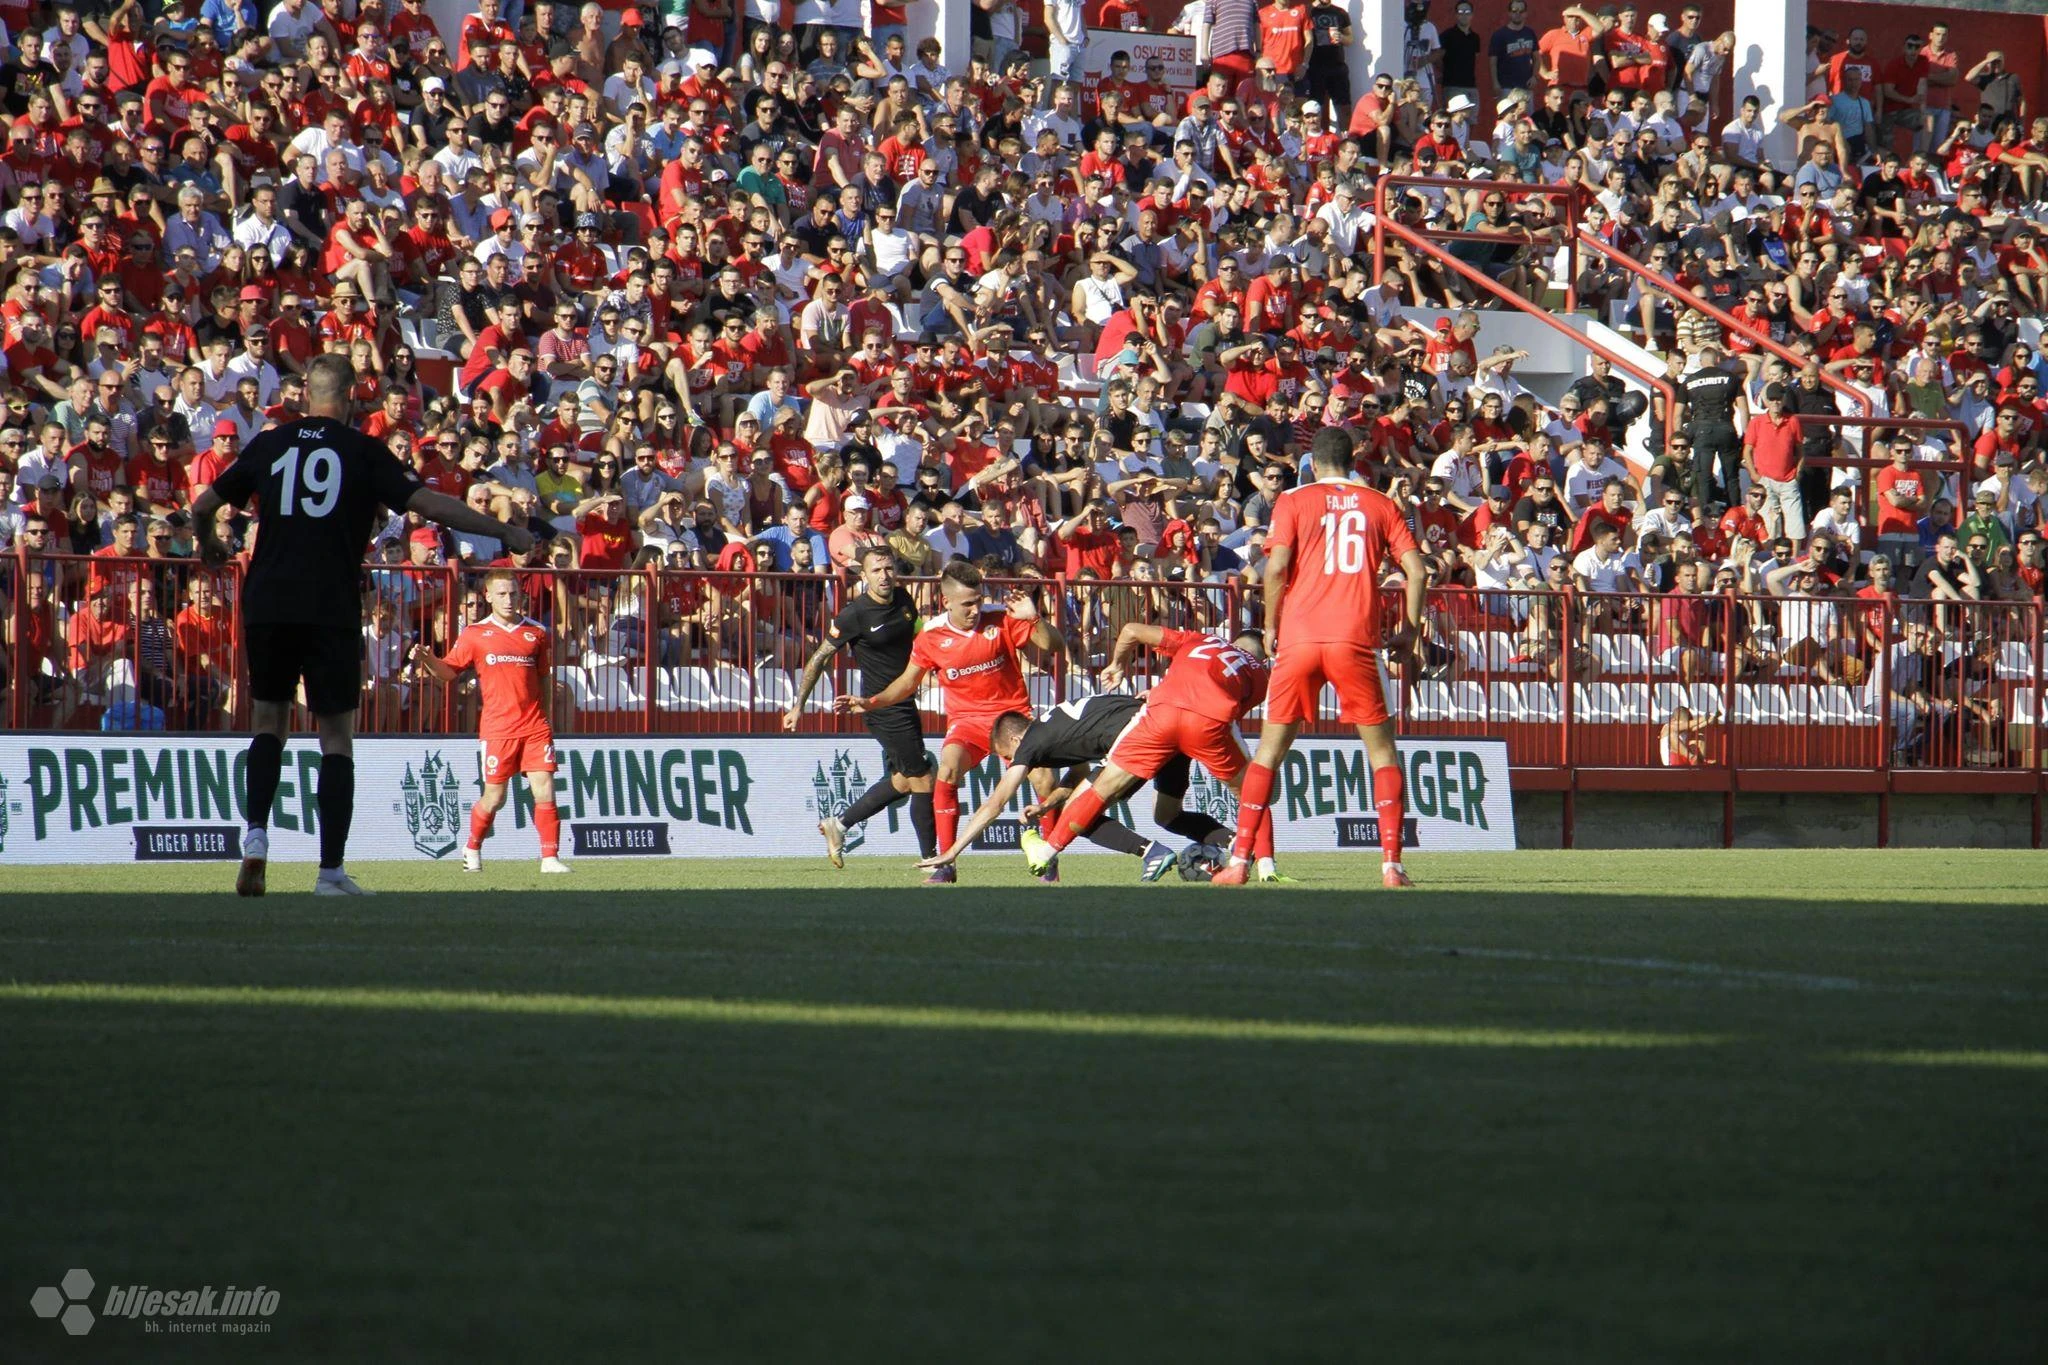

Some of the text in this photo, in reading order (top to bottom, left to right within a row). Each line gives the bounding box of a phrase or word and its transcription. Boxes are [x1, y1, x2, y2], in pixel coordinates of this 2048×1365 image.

[1686, 376, 1730, 391] SECURITY
[271, 447, 342, 518] 19
[1325, 492, 1359, 511] FAJIĆ
[1320, 510, 1366, 575] 16
[1187, 636, 1249, 678] 24
[586, 829, 656, 849] LAGER BEER
[983, 825, 1016, 844] LAGER
[1347, 823, 1379, 842] LAGER
[150, 833, 226, 853] LAGER BEER
